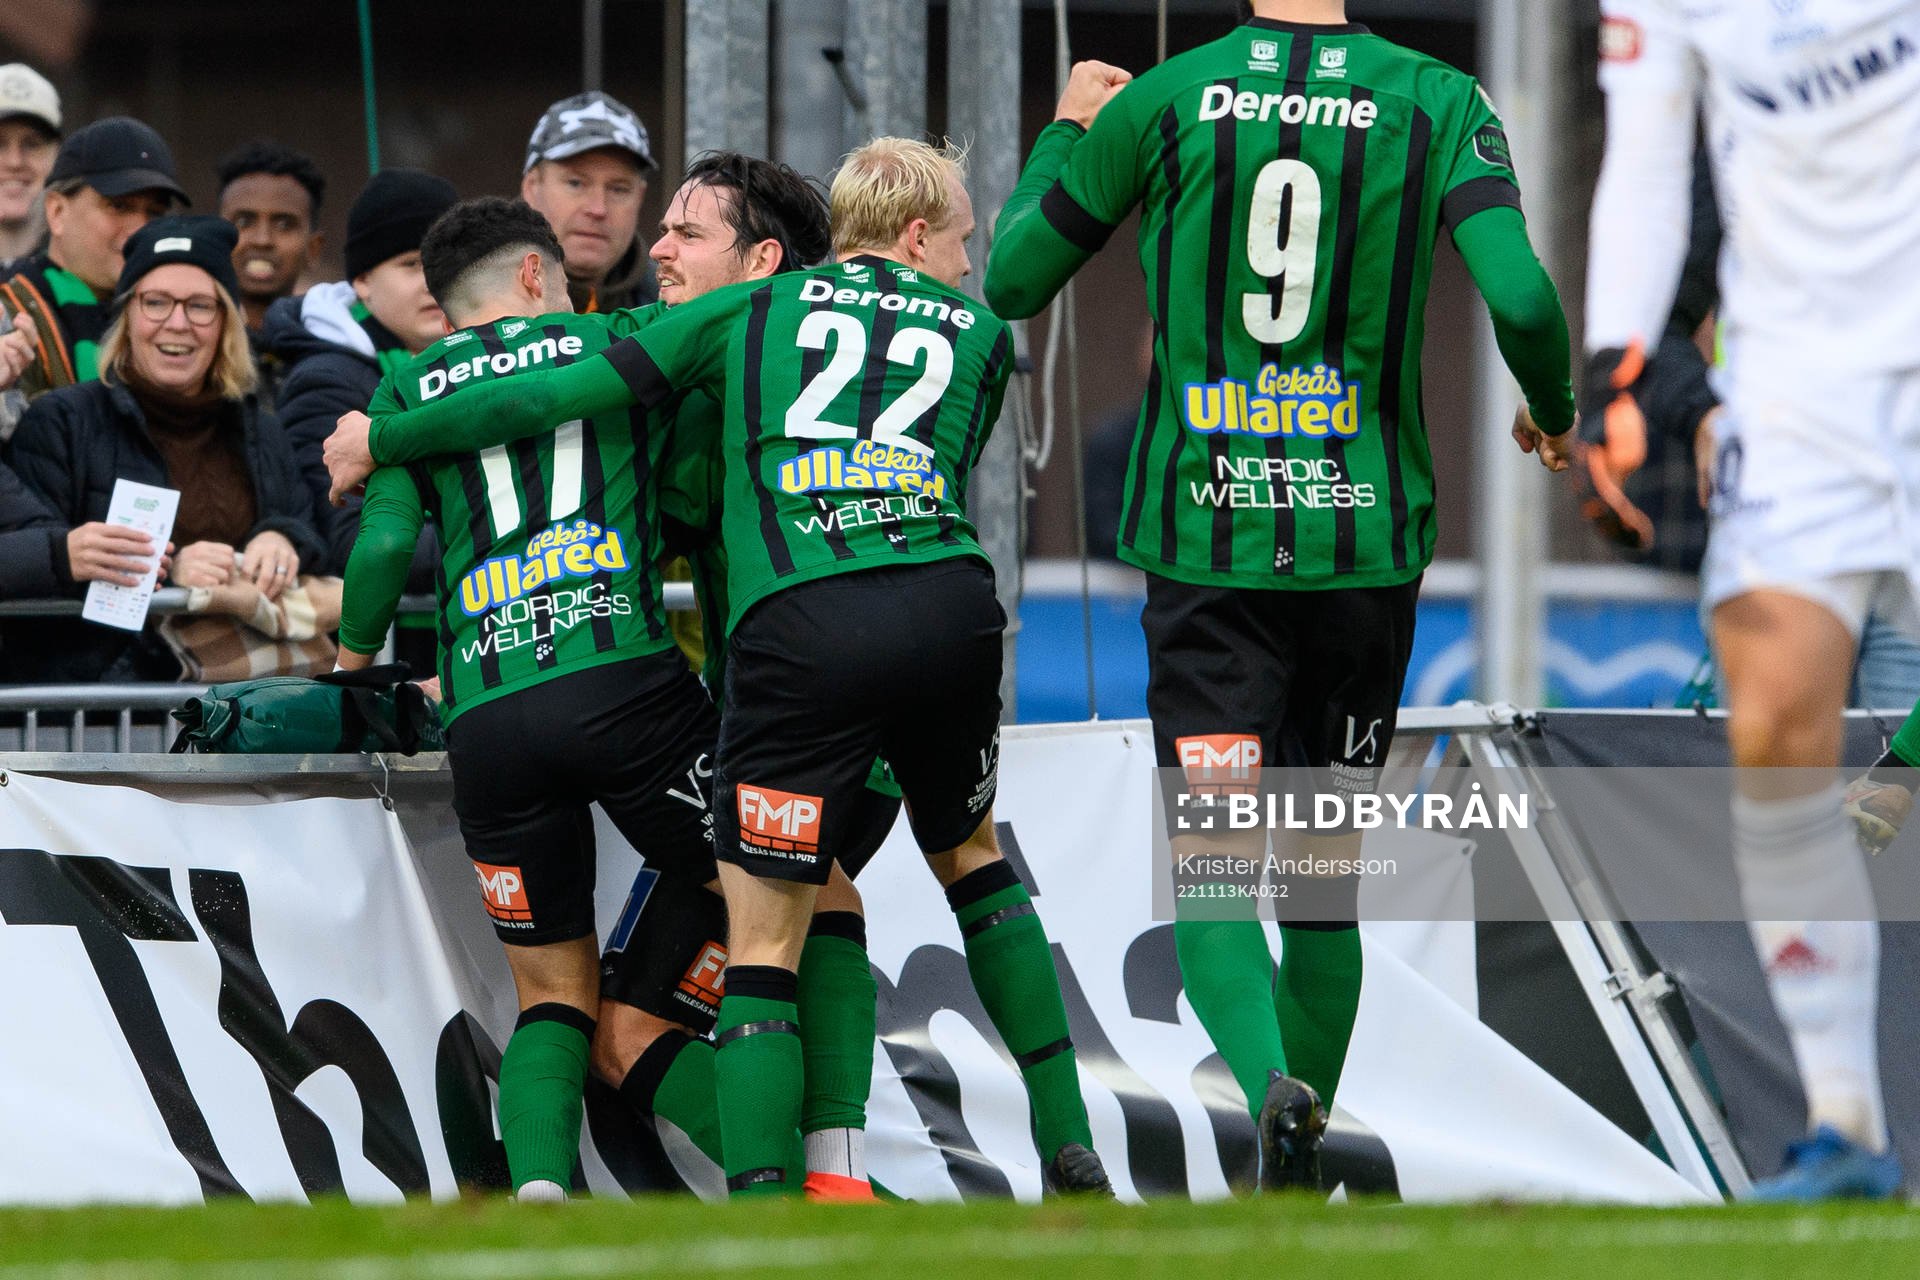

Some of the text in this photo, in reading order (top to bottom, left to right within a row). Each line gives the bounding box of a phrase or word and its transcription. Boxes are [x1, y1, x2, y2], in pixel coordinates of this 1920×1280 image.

[1199, 84, 1378, 129] Derome
[1242, 159, 1322, 344] 9
[799, 279, 975, 330] Derome
[418, 335, 583, 401] Derome
[784, 310, 955, 459] 22
[1257, 364, 1342, 396] Gekås
[1187, 381, 1358, 435] Ullared
[781, 451, 945, 499] Ullared
[1216, 455, 1341, 482] NORDIC
[818, 493, 937, 519] RDIC
[1190, 481, 1376, 509] WELLNESS
[526, 521, 602, 557] Gekås
[462, 531, 626, 612] Ullared
[484, 583, 605, 632] NORDIC
[1180, 740, 1261, 781] FMP
[740, 789, 818, 837] FMP
[796, 853, 817, 864] PUTS
[673, 991, 708, 1013] FRILLESÅS
